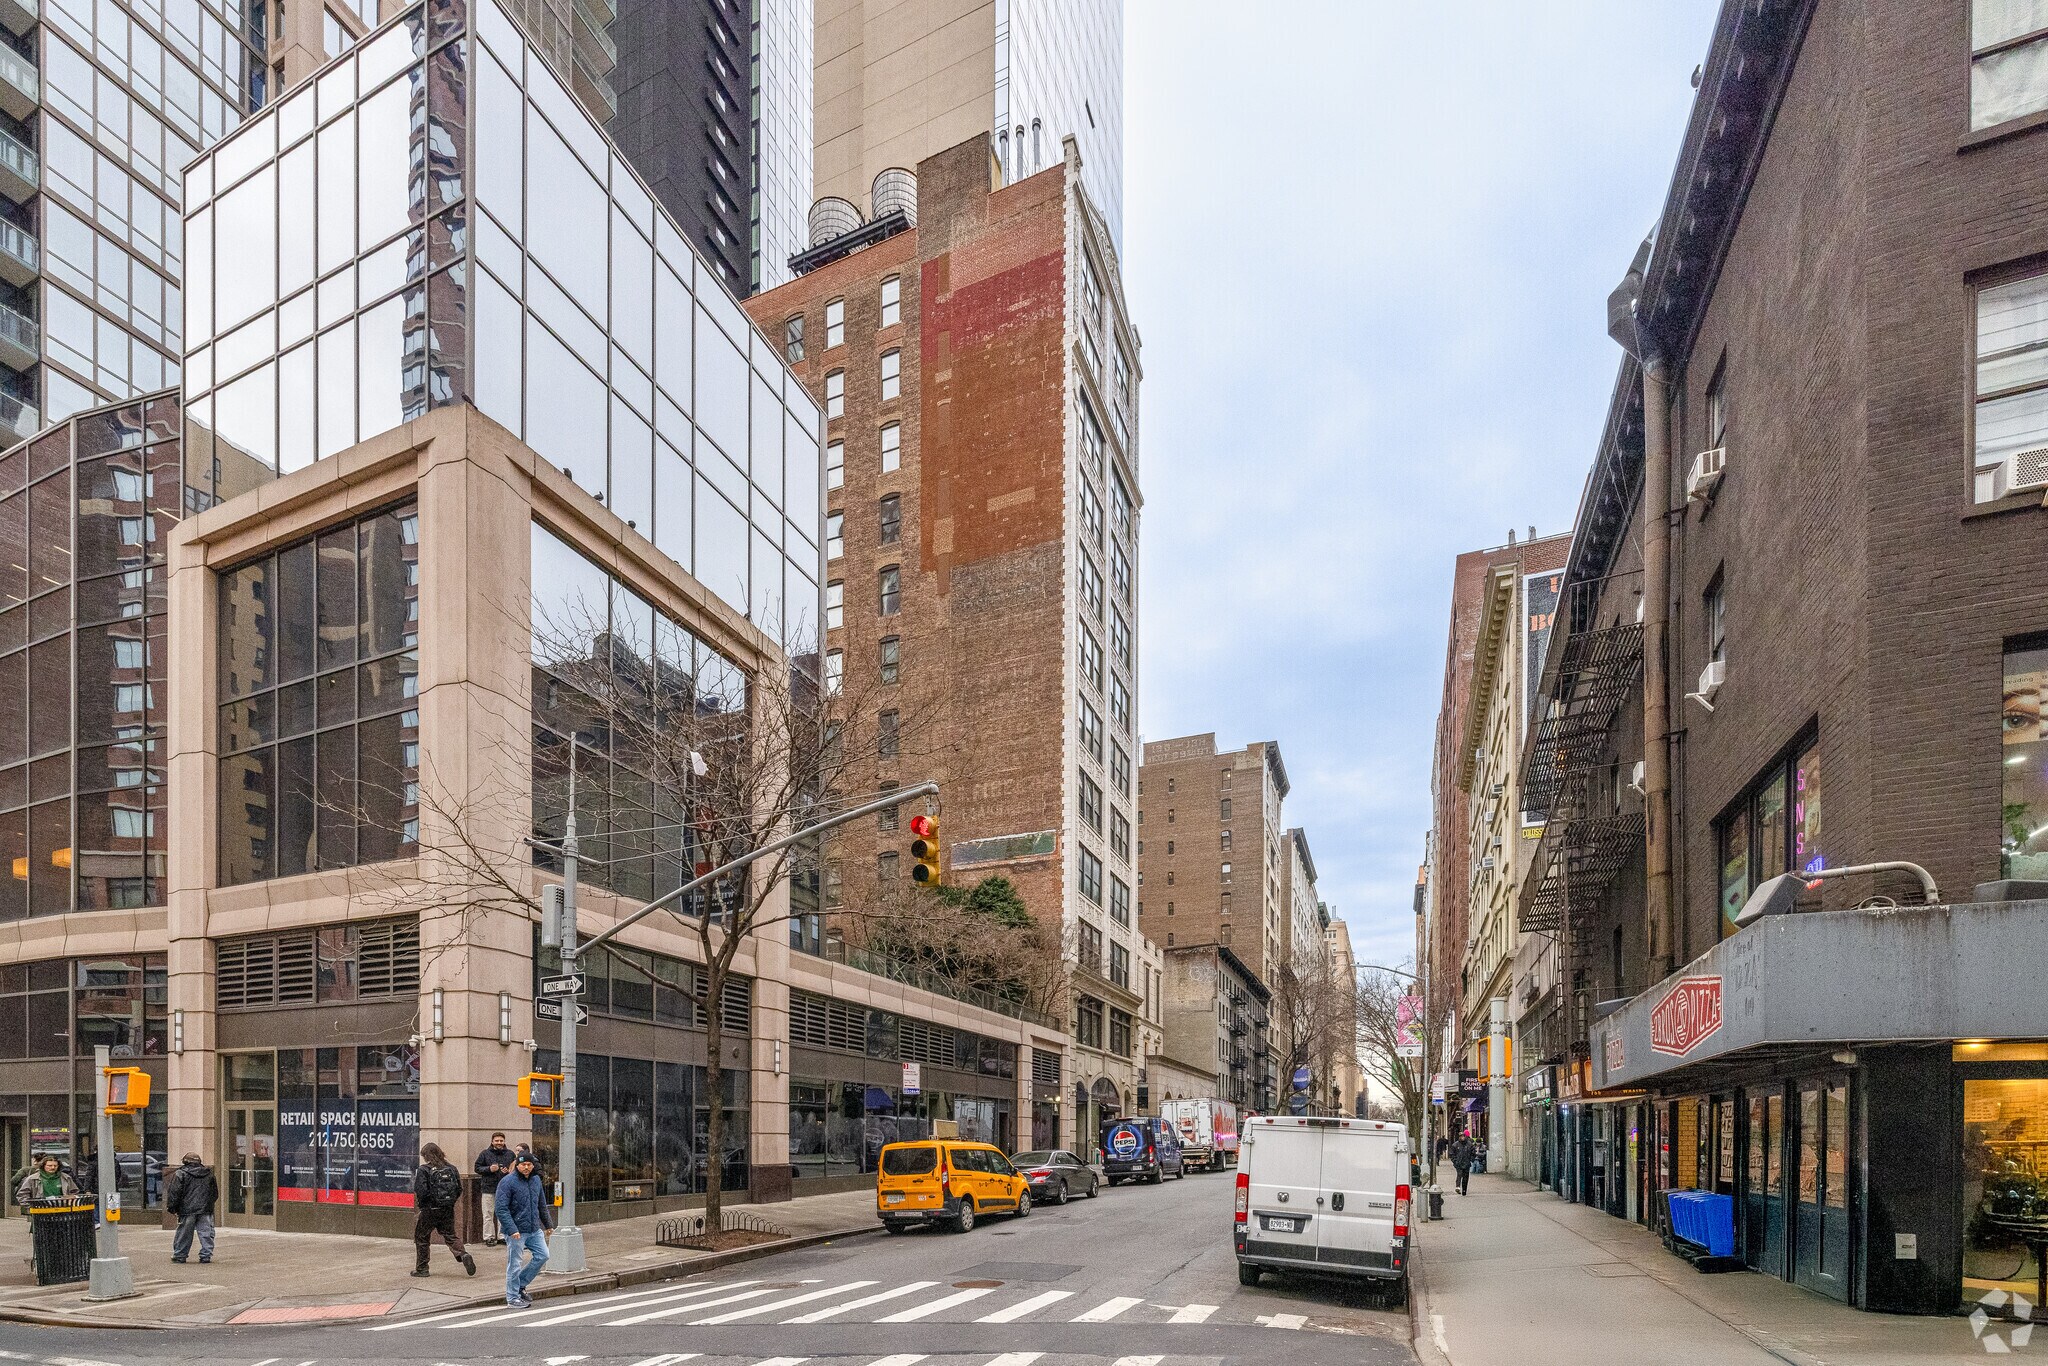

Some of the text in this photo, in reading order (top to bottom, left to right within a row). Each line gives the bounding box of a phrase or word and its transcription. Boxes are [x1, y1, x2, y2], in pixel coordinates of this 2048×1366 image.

[546, 980, 579, 992] ONE WAY
[541, 1004, 557, 1015] ONE
[1690, 988, 1718, 1039] PIZZA
[320, 1112, 356, 1126] SPACE
[360, 1112, 419, 1127] AVAILABL
[308, 1131, 395, 1149] 212.750.6565
